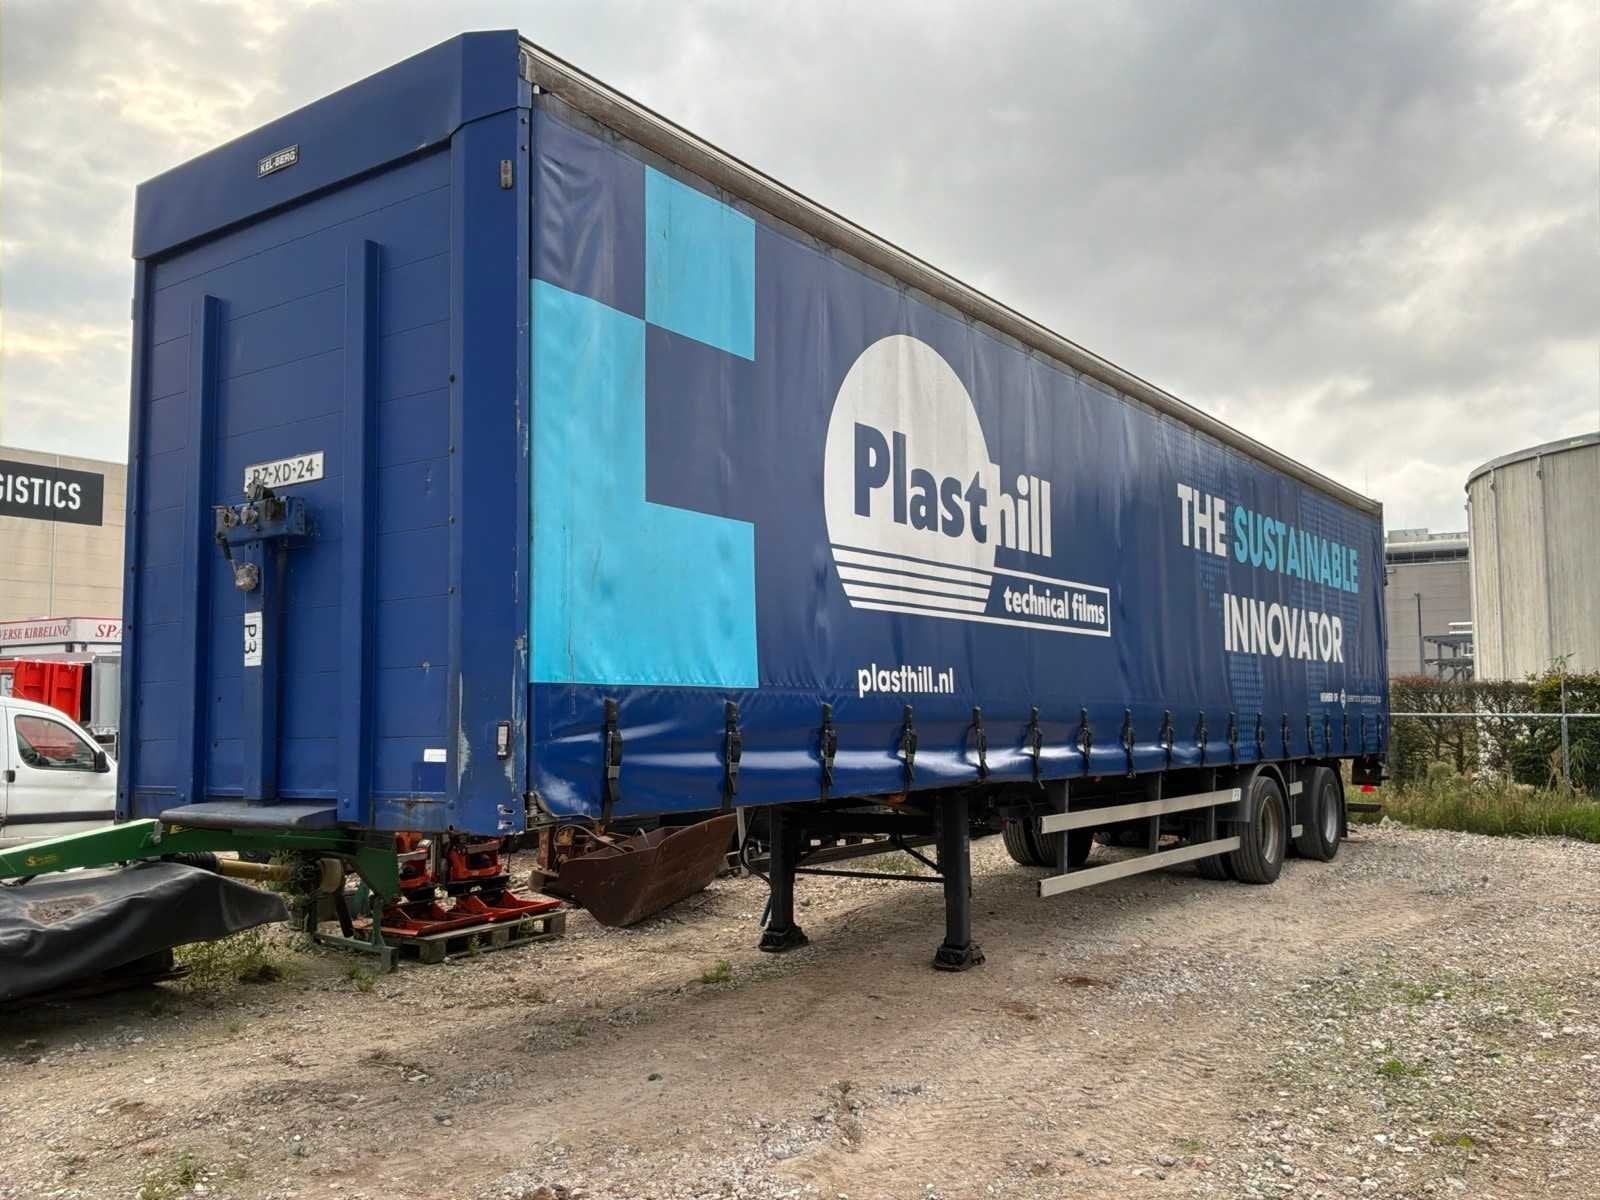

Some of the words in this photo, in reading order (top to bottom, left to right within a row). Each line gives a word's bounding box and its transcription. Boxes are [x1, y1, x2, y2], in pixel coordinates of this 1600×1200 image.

[260, 151, 296, 174] KEL-BERG
[854, 421, 1051, 558] Plasthill
[1177, 483, 1227, 557] THE
[1234, 505, 1359, 593] SUSTAINABLE
[1003, 584, 1069, 619] technical
[1072, 592, 1105, 625] films
[0, 628, 23, 640] ERSE
[1223, 593, 1344, 663] INNOVATOR
[858, 663, 955, 699] plasthill.nl
